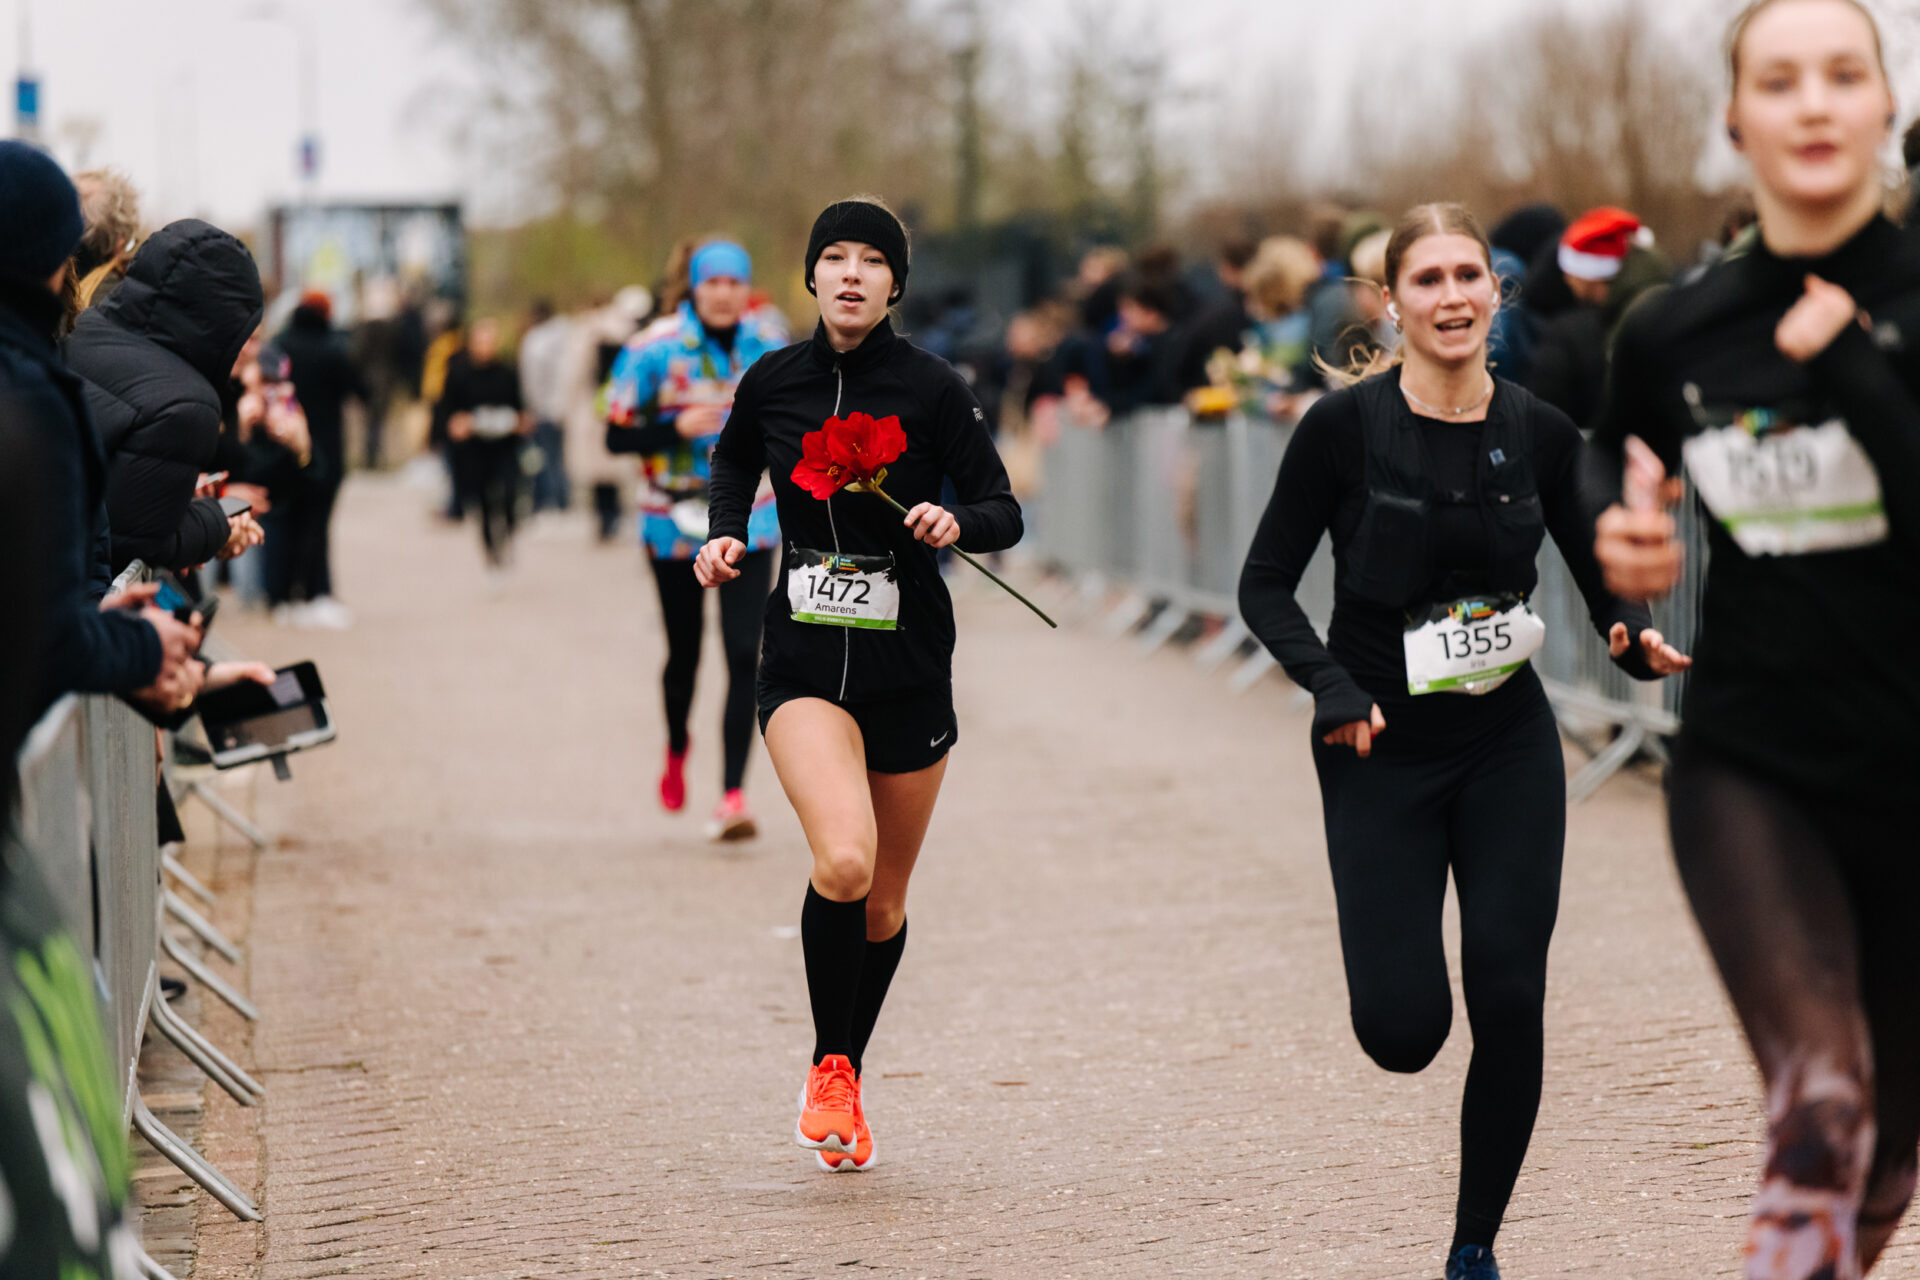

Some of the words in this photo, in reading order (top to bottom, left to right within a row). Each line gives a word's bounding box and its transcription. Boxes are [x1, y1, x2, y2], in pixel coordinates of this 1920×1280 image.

[808, 575, 871, 604] 1472
[815, 603, 857, 614] Amarens
[1437, 622, 1512, 660] 1355
